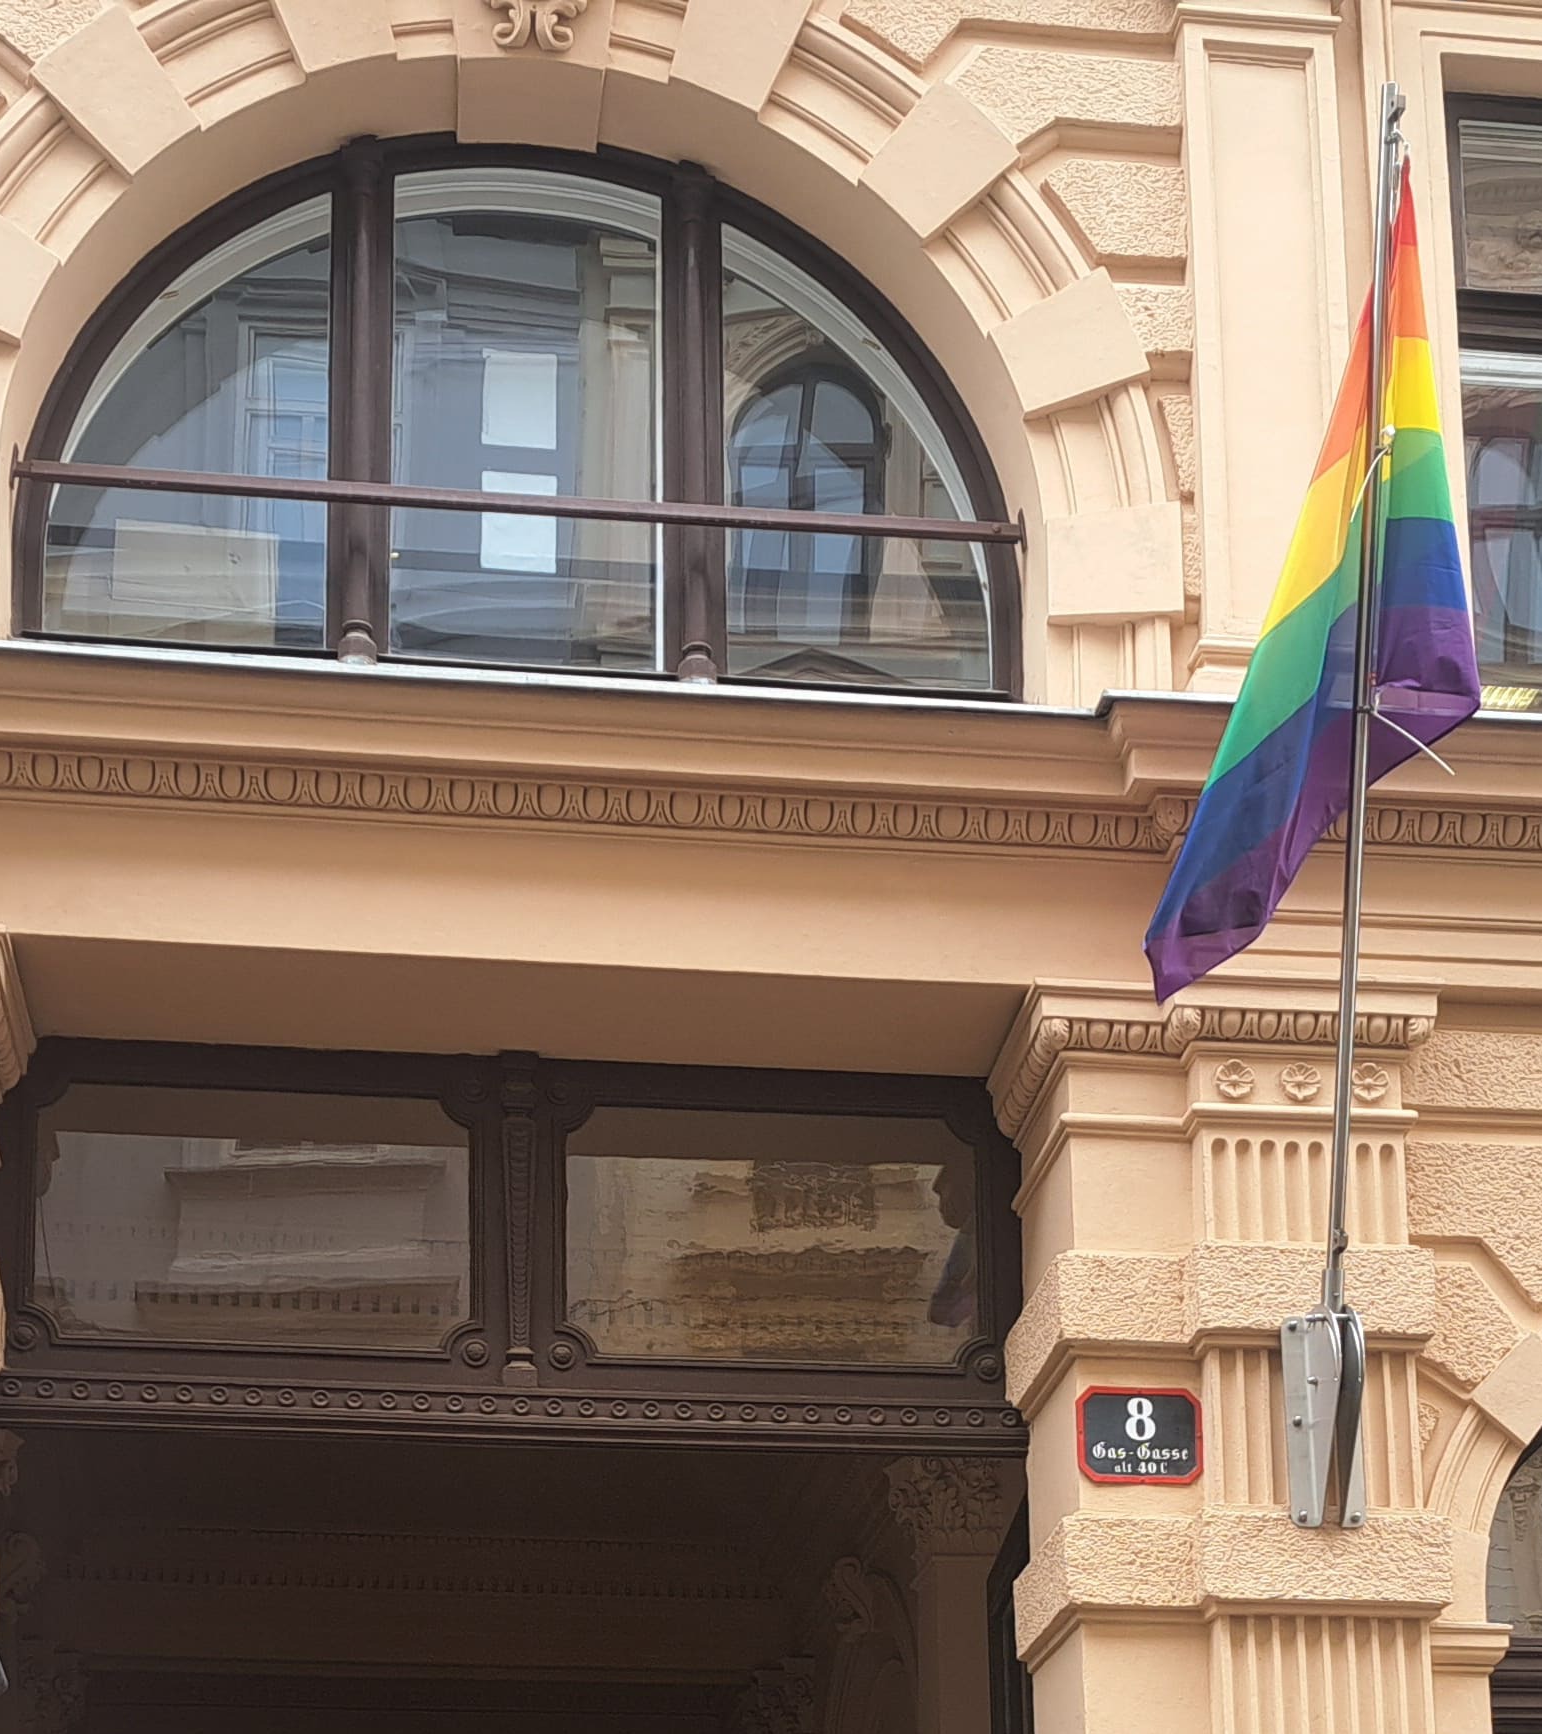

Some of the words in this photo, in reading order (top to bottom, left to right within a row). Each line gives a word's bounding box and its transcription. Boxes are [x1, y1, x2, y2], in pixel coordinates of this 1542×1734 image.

[1125, 1397, 1156, 1441] 8
[1092, 1442, 1189, 1460] Gas-Gasse
[1114, 1462, 1132, 1473] alt
